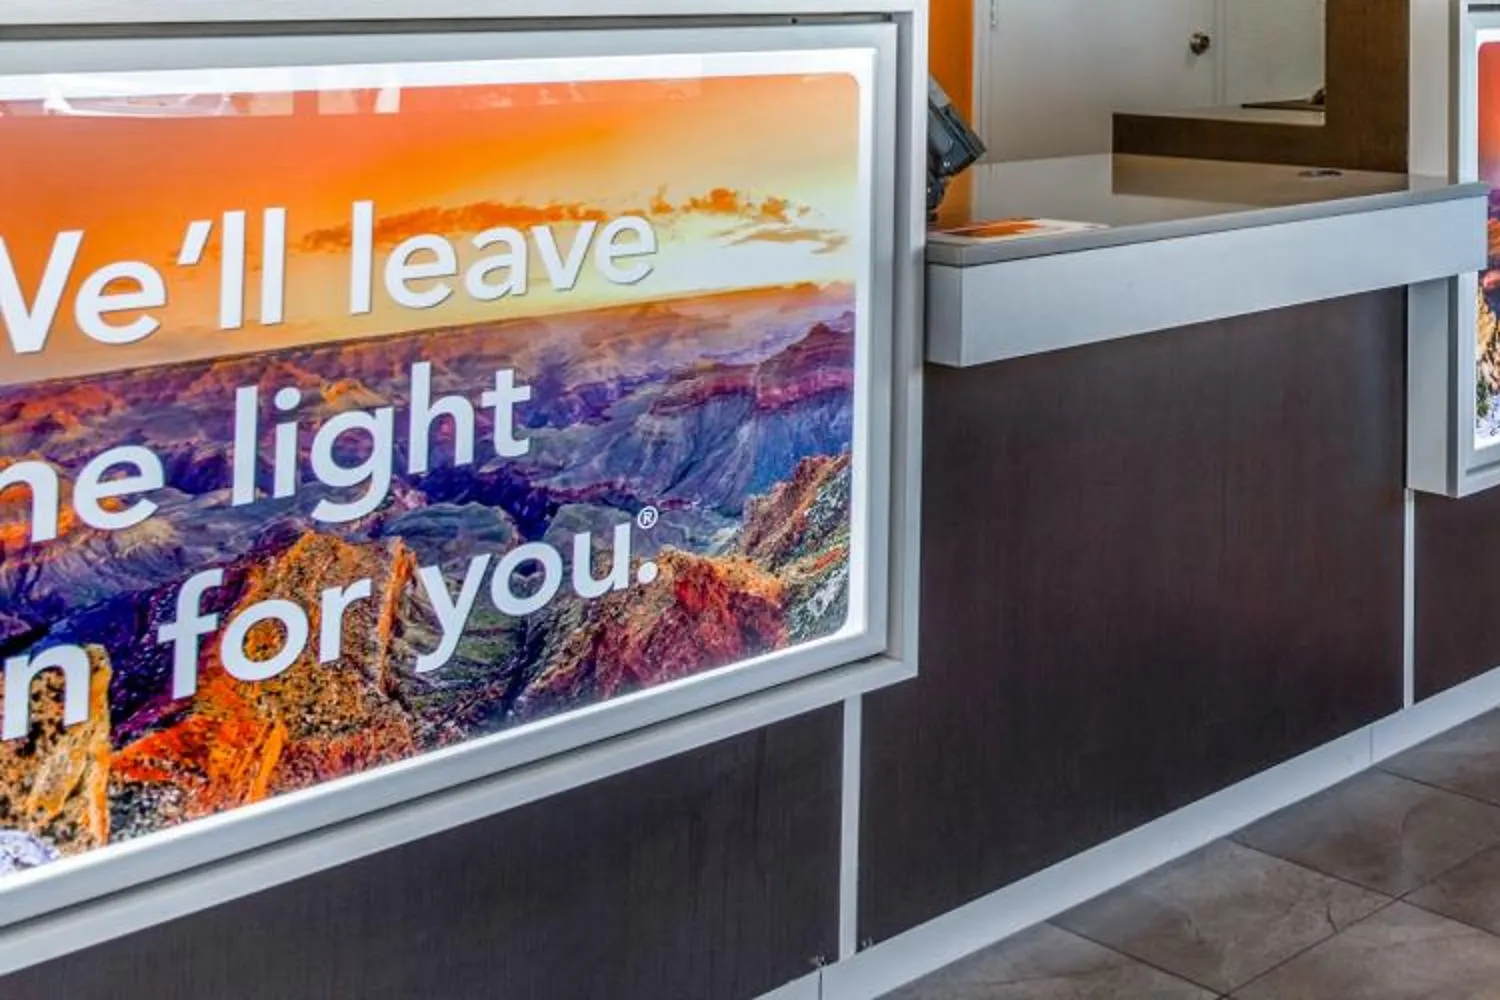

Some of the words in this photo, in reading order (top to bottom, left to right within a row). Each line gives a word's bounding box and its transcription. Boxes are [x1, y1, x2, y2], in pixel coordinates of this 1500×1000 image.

[350, 199, 658, 316] leave
[231, 361, 531, 523] light
[157, 568, 373, 700] for
